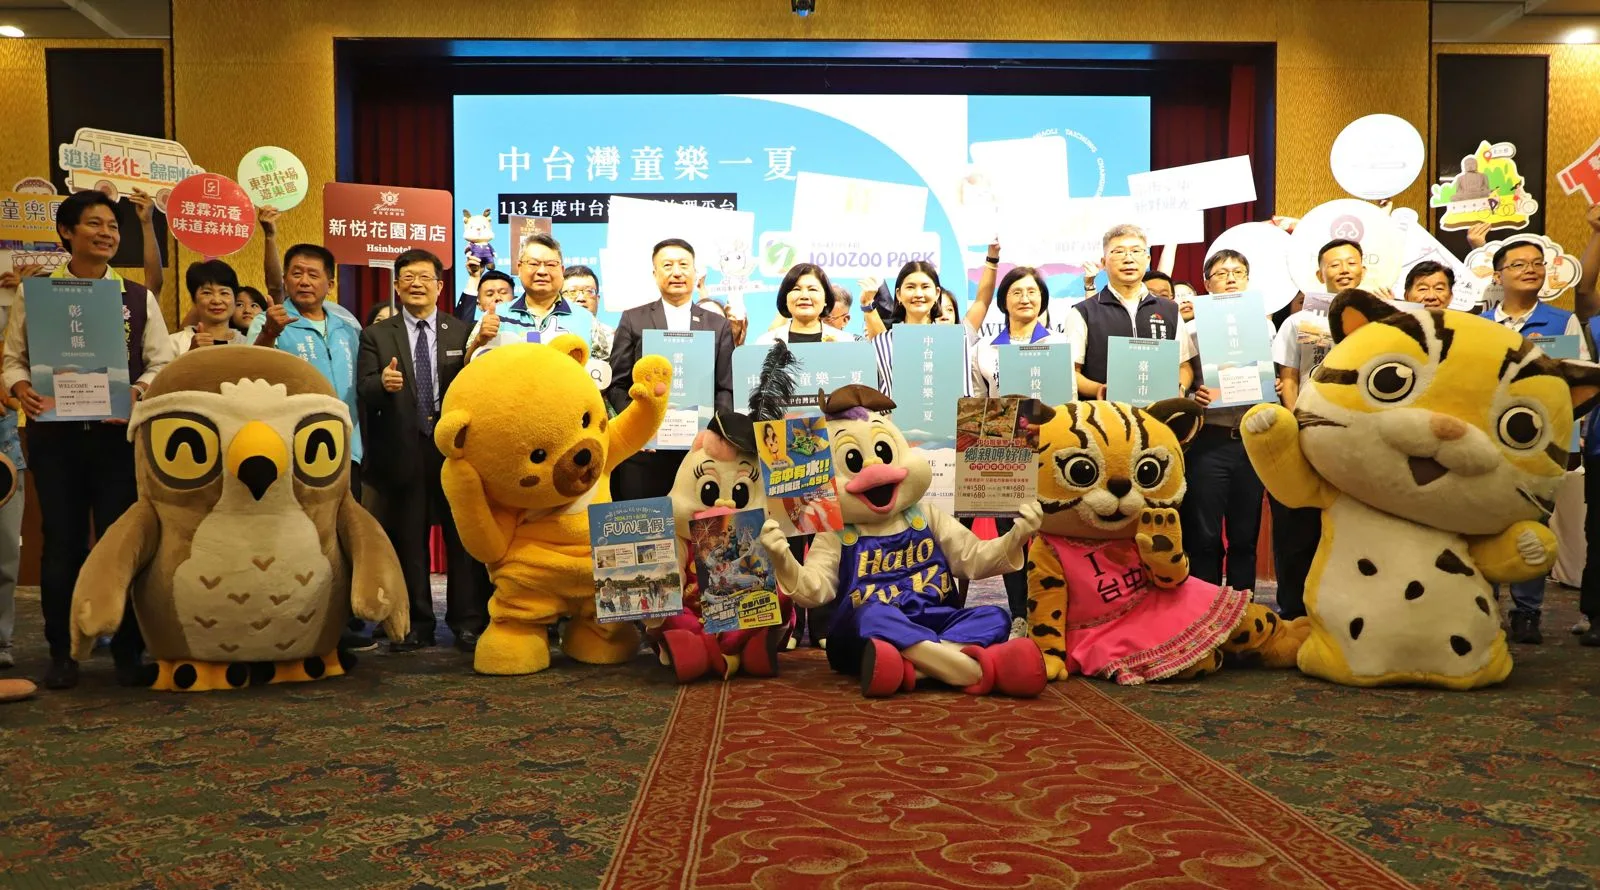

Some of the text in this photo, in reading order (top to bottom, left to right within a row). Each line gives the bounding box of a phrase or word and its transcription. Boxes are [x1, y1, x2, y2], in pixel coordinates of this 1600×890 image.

[499, 145, 797, 182] 中台灣童樂一夏
[259, 182, 298, 200] 遊樂區
[180, 200, 242, 221] 澄霖沉香
[172, 217, 250, 239] 味道森林館
[809, 251, 882, 268] JOJOZOO
[68, 304, 86, 349] 彰化縣
[923, 336, 934, 422] 中台灣童樂一夏
[857, 537, 935, 577] Hato
[1084, 552, 1105, 577] I
